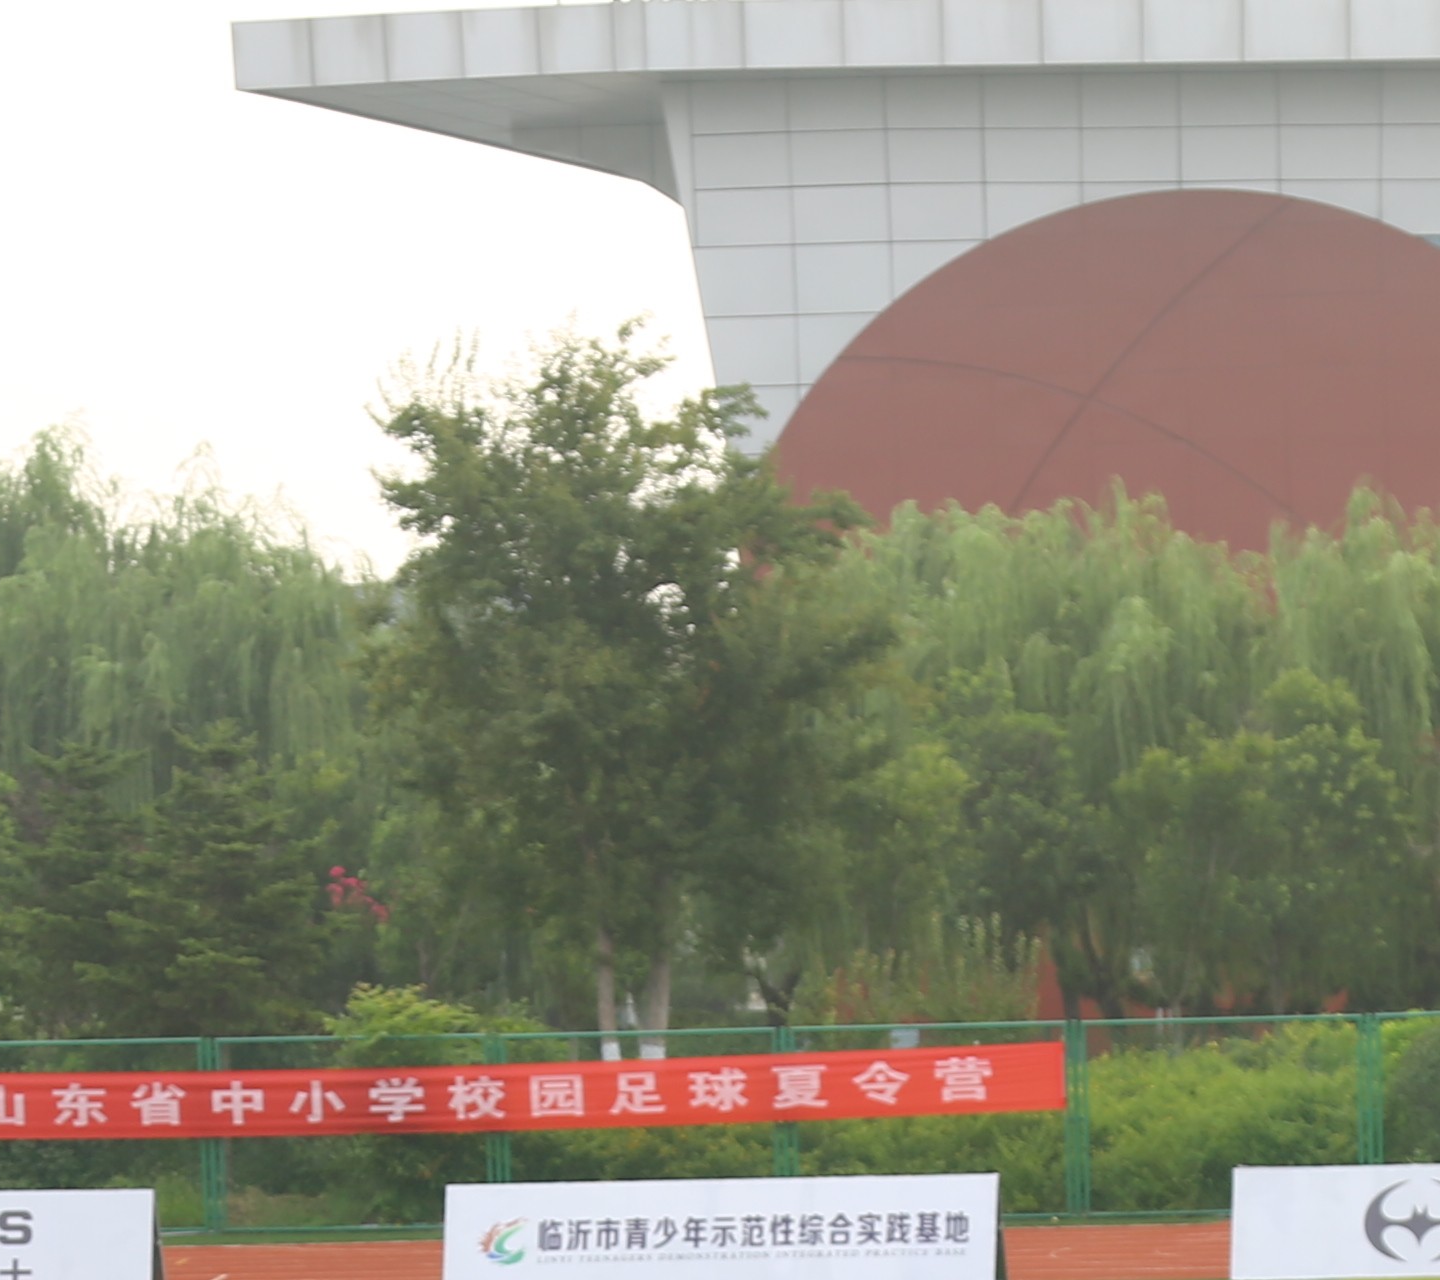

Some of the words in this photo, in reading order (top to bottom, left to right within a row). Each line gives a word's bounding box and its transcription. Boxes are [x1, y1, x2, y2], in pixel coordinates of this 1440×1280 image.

[537, 1211, 971, 1252] 临沂市青少年示范性综合实践基地
